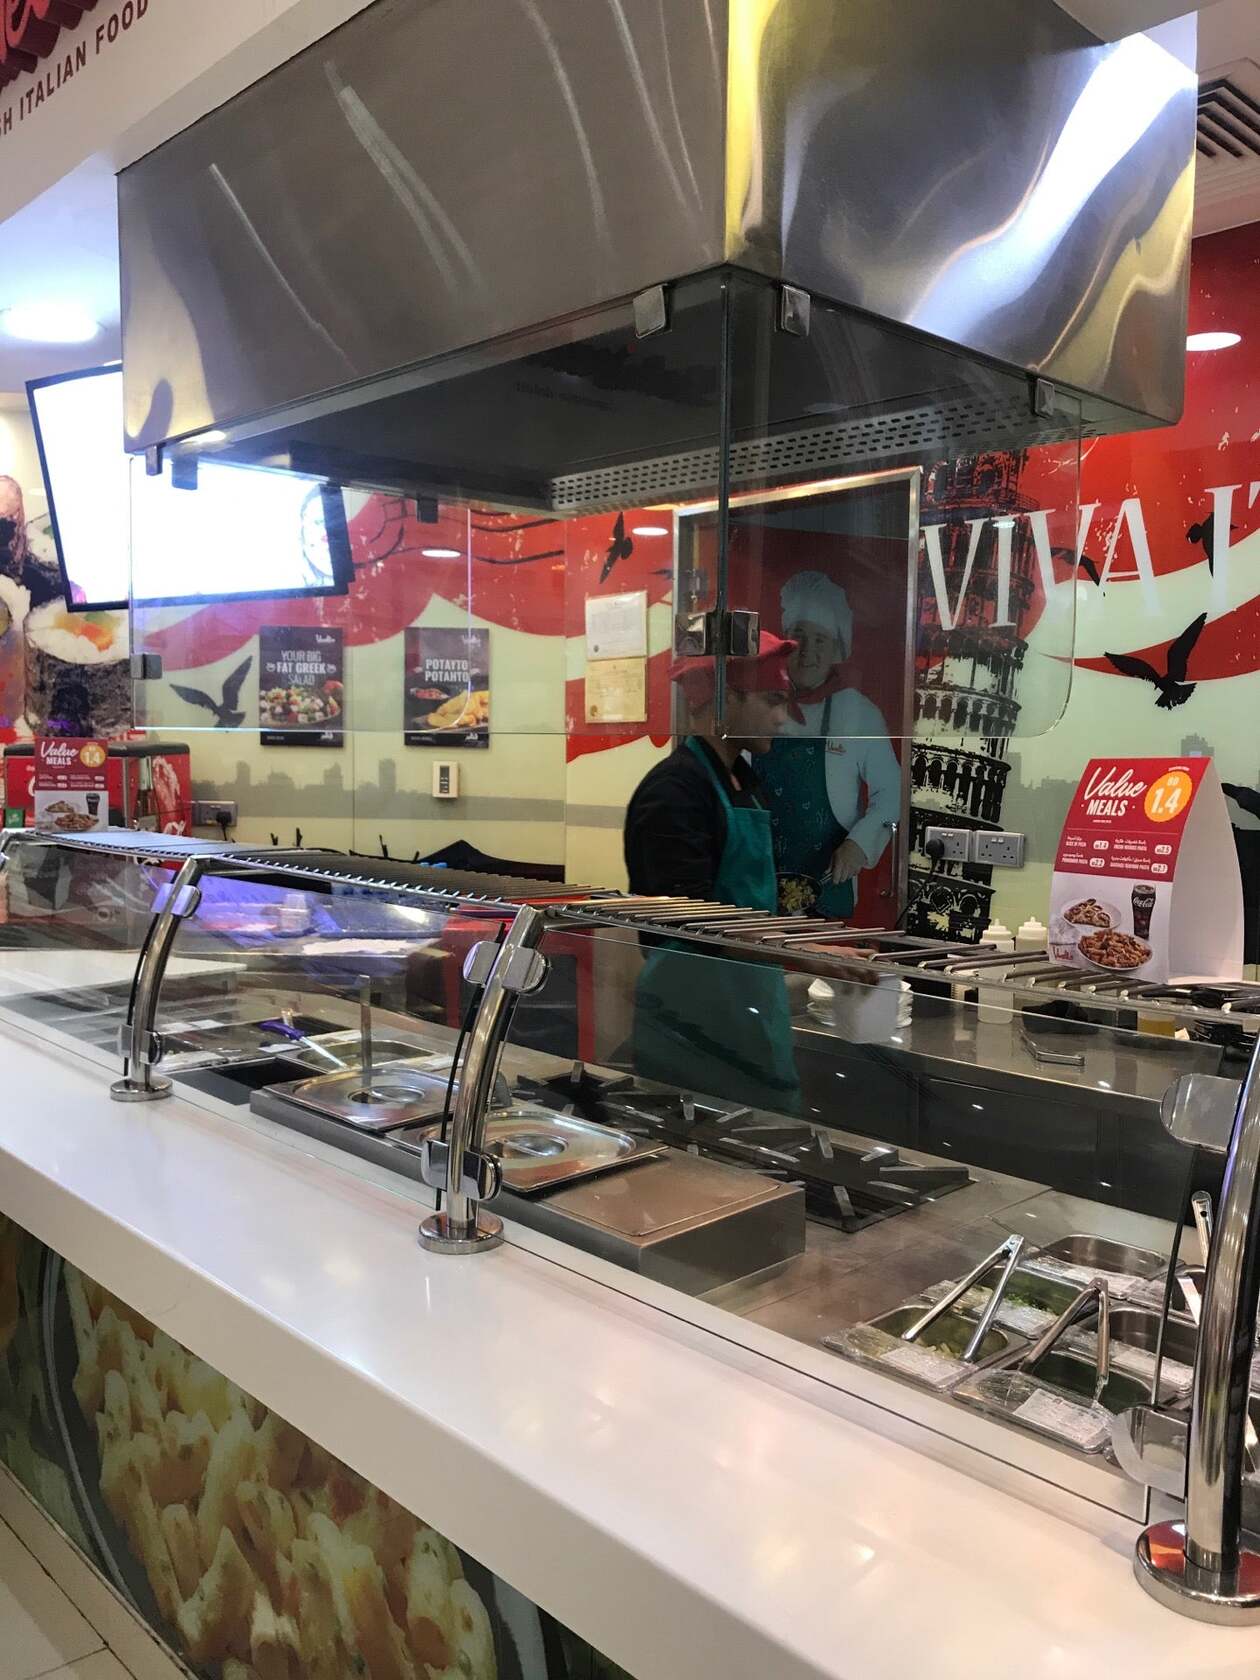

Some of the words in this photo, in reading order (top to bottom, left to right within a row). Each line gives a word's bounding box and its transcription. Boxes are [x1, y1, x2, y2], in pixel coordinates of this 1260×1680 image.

[20, 40, 86, 120] ITALIAN
[95, 0, 148, 55] FOOD
[920, 497, 1163, 630] VIVA
[1204, 481, 1260, 614] I
[276, 662, 293, 673] FAT
[296, 662, 326, 673] GREEK
[425, 659, 468, 670] POTAYTO
[41, 741, 79, 758] Value
[46, 757, 72, 766] MEALS
[1083, 766, 1148, 800] Value
[1086, 800, 1128, 816] MEALS
[1151, 787, 1182, 814] 1.4
